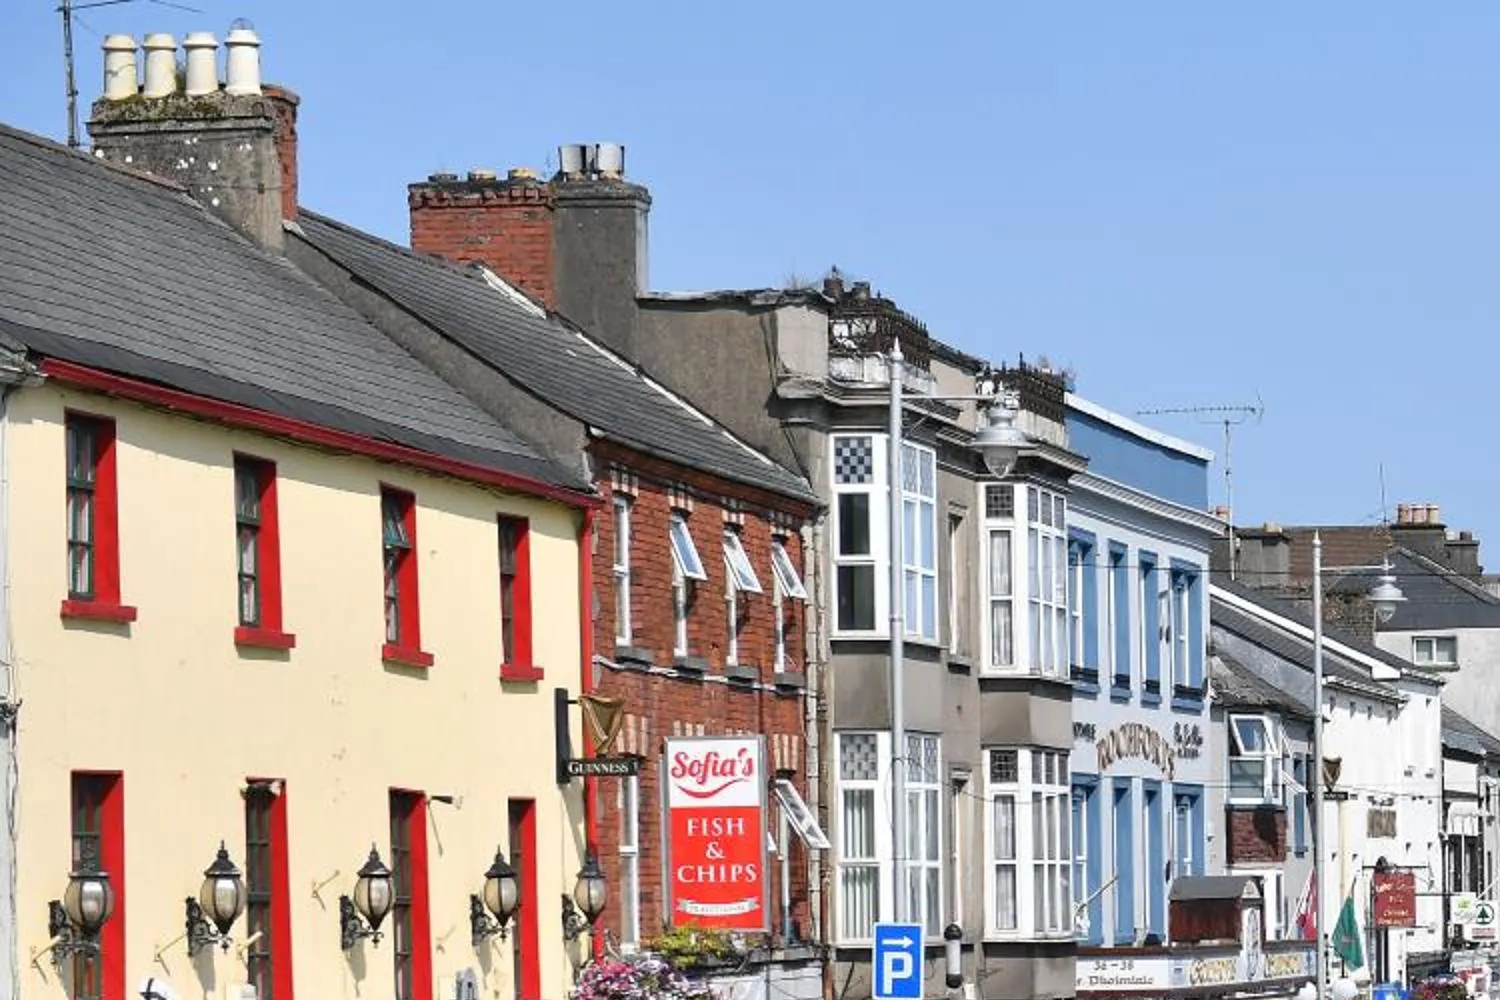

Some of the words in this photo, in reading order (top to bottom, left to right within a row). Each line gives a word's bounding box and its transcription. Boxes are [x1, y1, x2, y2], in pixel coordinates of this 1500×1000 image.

[671, 747, 754, 784] Sofia's
[687, 817, 745, 836] FISH
[705, 841, 725, 859] &
[677, 863, 758, 883] CHIPS
[883, 951, 913, 995] P
